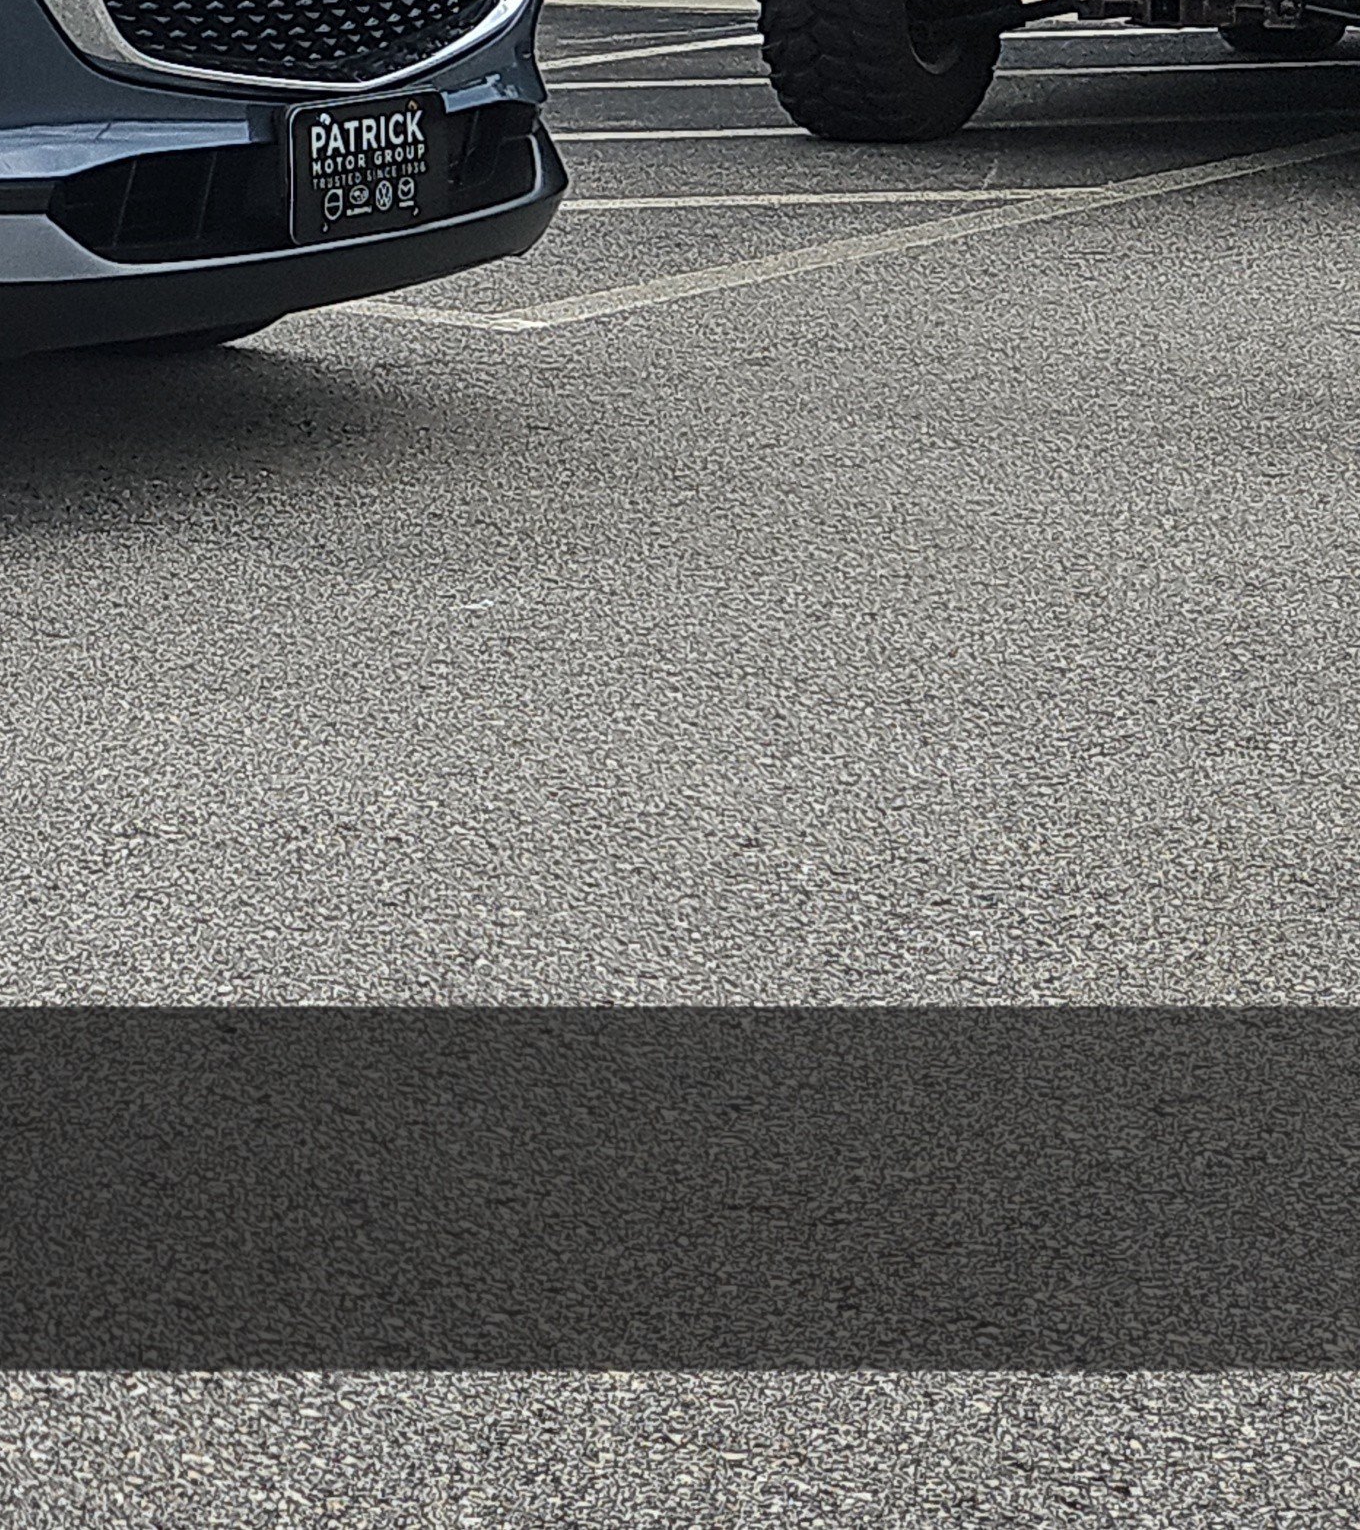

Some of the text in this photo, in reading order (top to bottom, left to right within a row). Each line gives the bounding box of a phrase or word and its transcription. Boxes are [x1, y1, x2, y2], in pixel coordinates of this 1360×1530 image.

[311, 110, 425, 159] PATRICK
[312, 143, 425, 176] MOTOR GROUP
[312, 172, 362, 190] TRUSTED
[367, 165, 397, 181] SINCE
